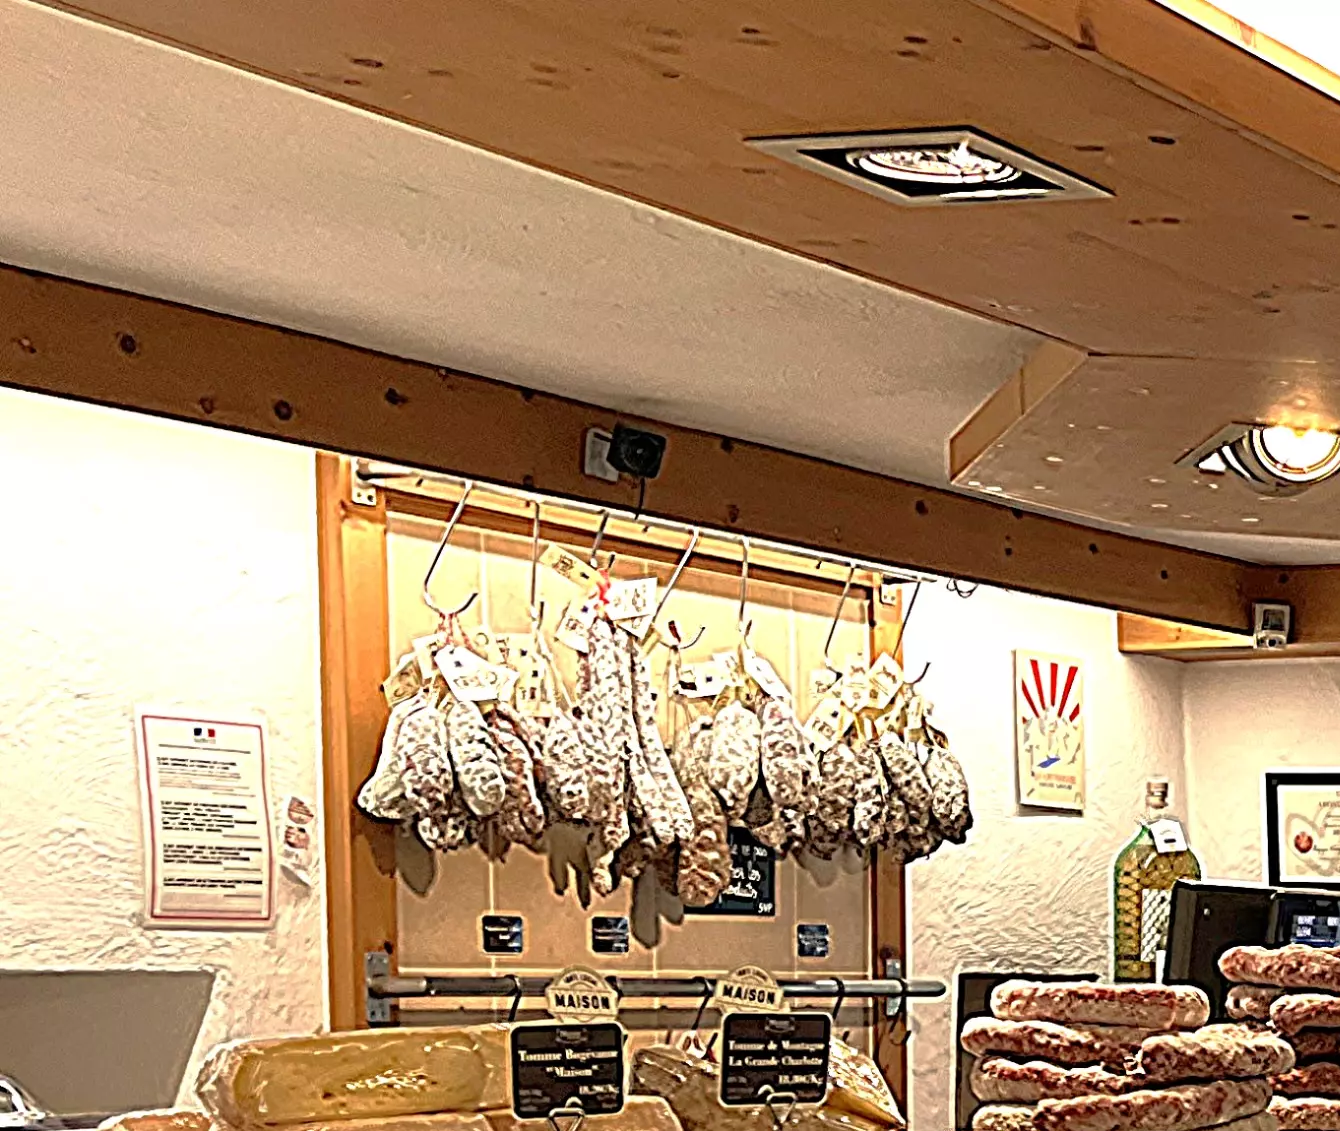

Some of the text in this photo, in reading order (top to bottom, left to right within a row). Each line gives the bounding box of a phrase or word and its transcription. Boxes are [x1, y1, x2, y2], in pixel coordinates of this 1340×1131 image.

[758, 902, 773, 913] SVP
[723, 982, 776, 1005] MAISON
[555, 993, 611, 1010] MAISON
[518, 1050, 562, 1062] Tomme
[728, 1056, 742, 1066] La
